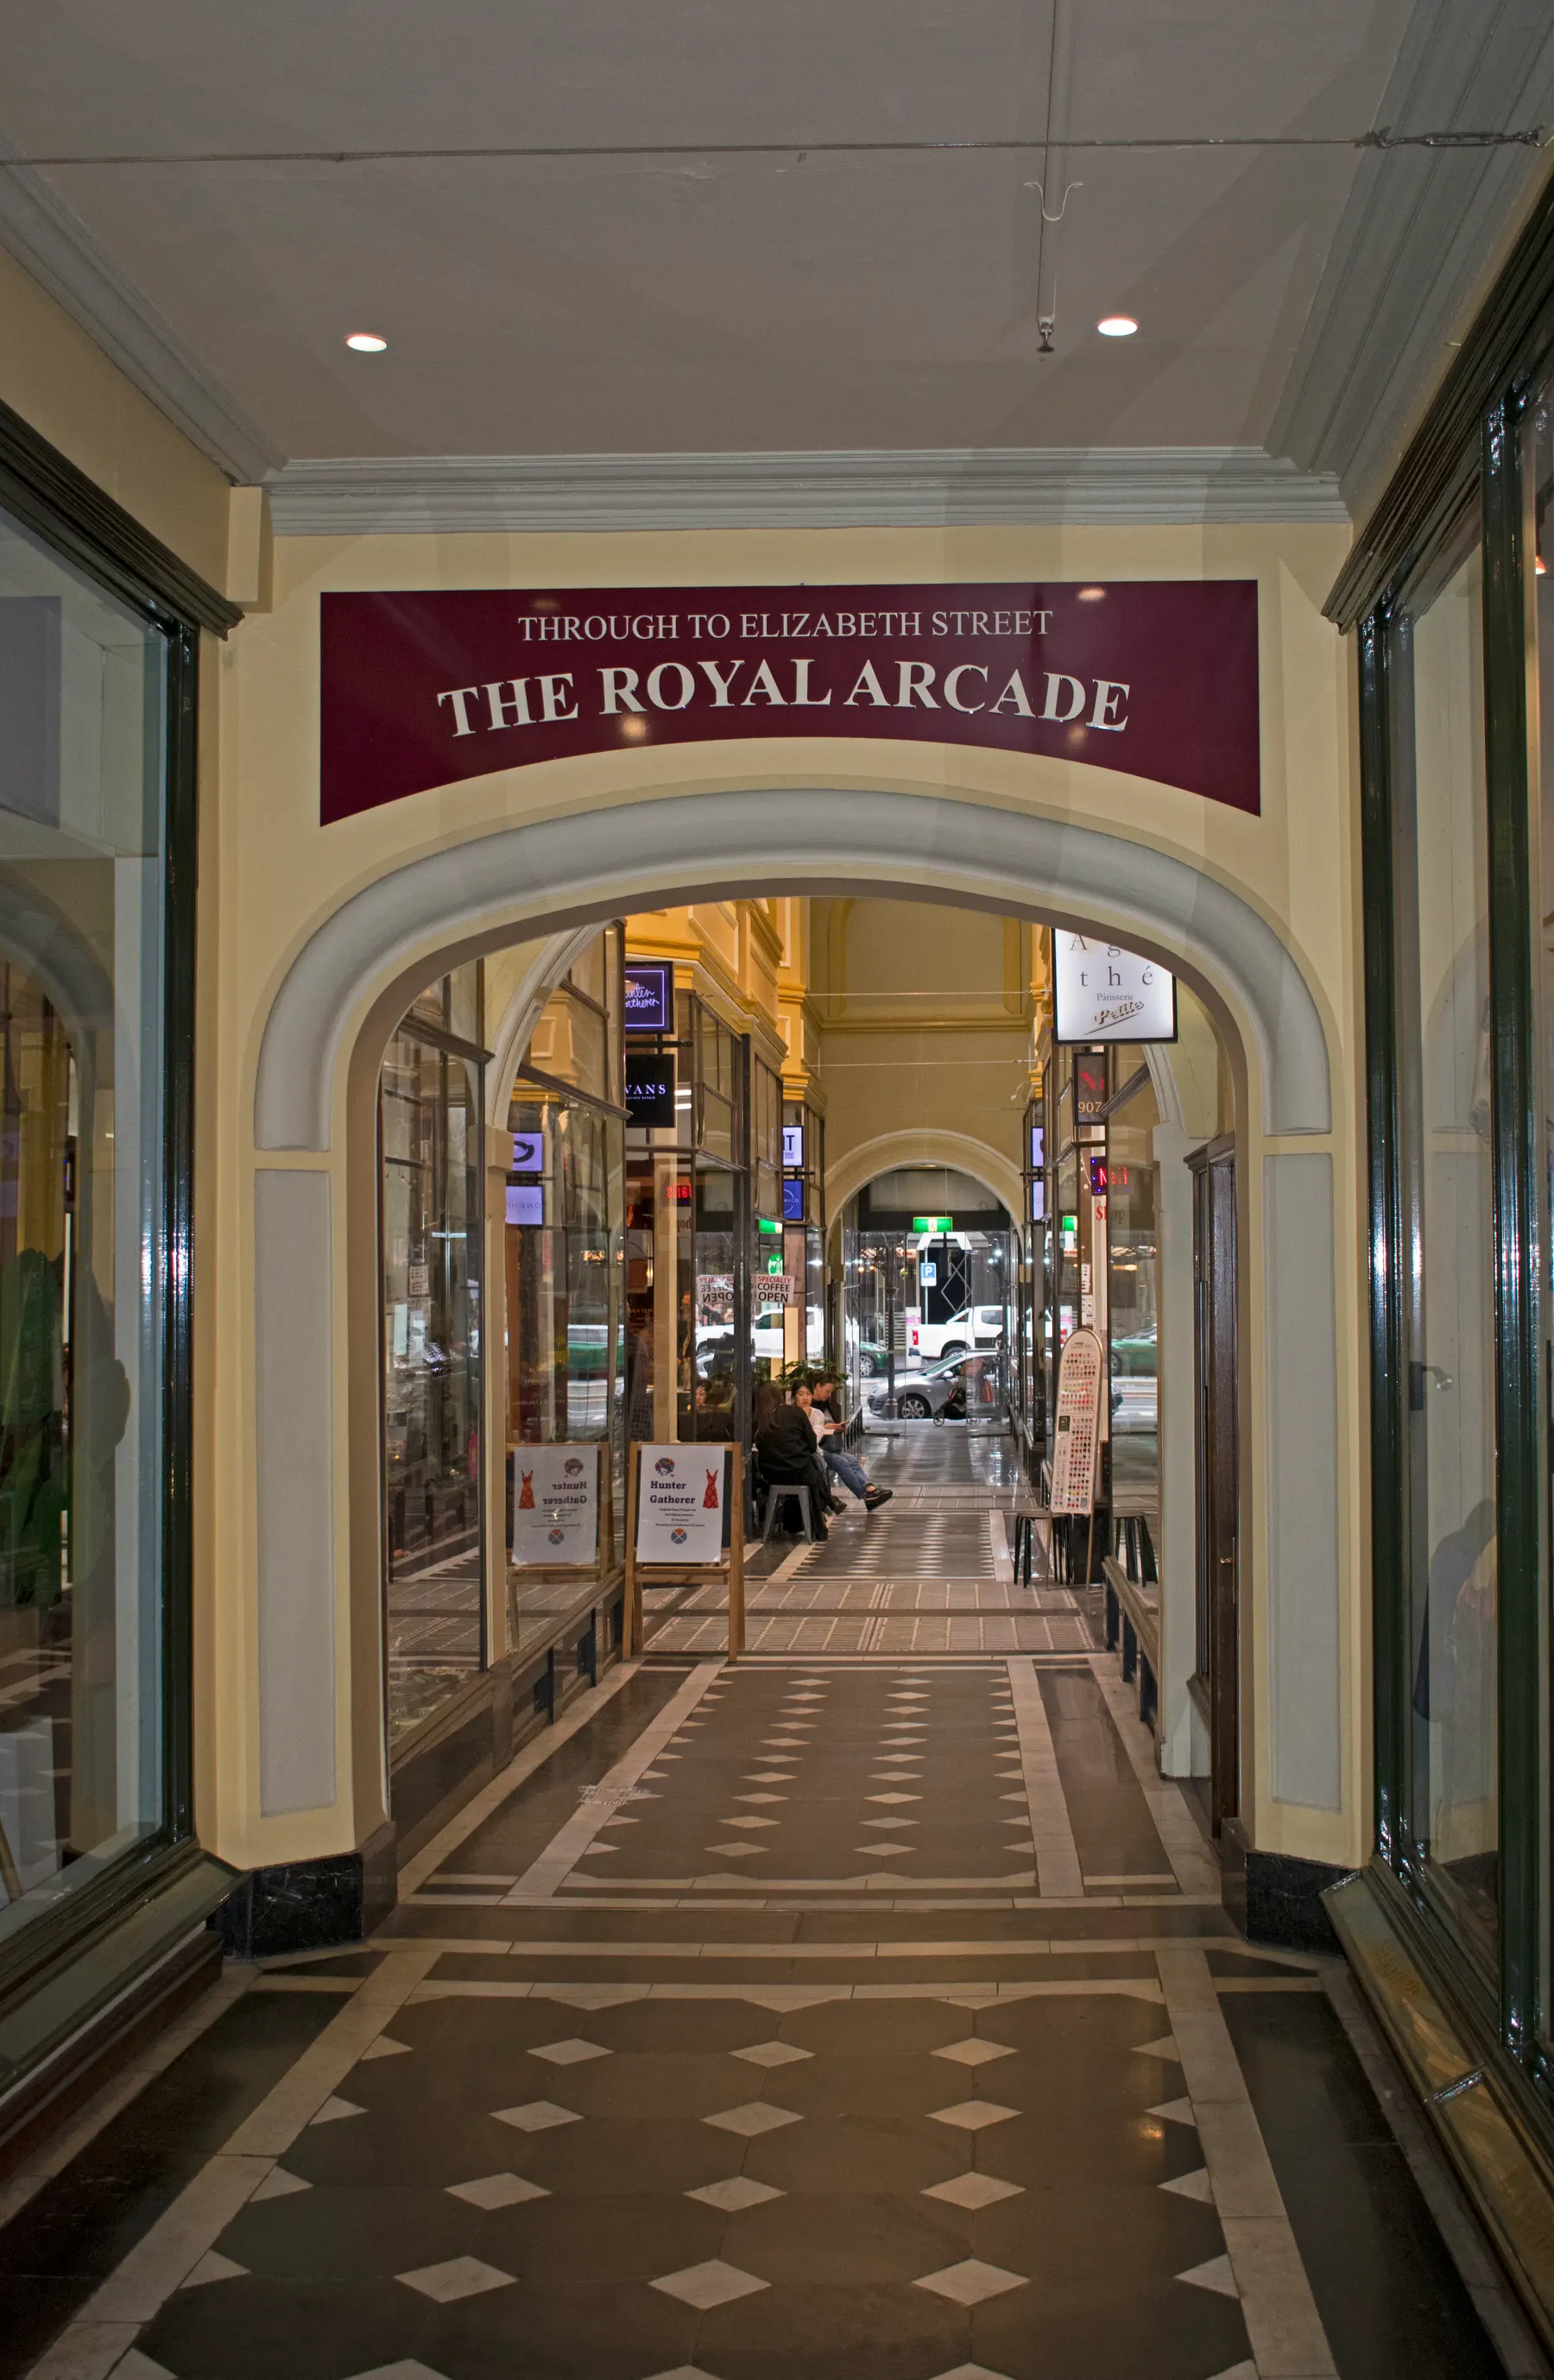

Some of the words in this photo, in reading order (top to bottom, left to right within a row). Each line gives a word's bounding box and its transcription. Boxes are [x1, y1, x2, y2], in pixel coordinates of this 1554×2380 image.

[518, 615, 679, 641] THROUGH
[688, 614, 730, 639] TO
[739, 612, 922, 638] ELIZABETH
[932, 610, 1053, 636] STREET
[437, 672, 578, 737] THE
[597, 658, 832, 715] ROYAL
[843, 659, 1130, 731] ARCADE
[625, 982, 655, 999] unter
[1096, 993, 1134, 1001] Pâtisserie
[625, 998, 660, 1008] atherer
[625, 1084, 666, 1095] VANS
[925, 1266, 932, 1278] P
[757, 1283, 790, 1291] COFFEE
[758, 1292, 788, 1303] OPEN
[650, 1480, 686, 1489] Hunter
[650, 1495, 695, 1504] Gatherer
